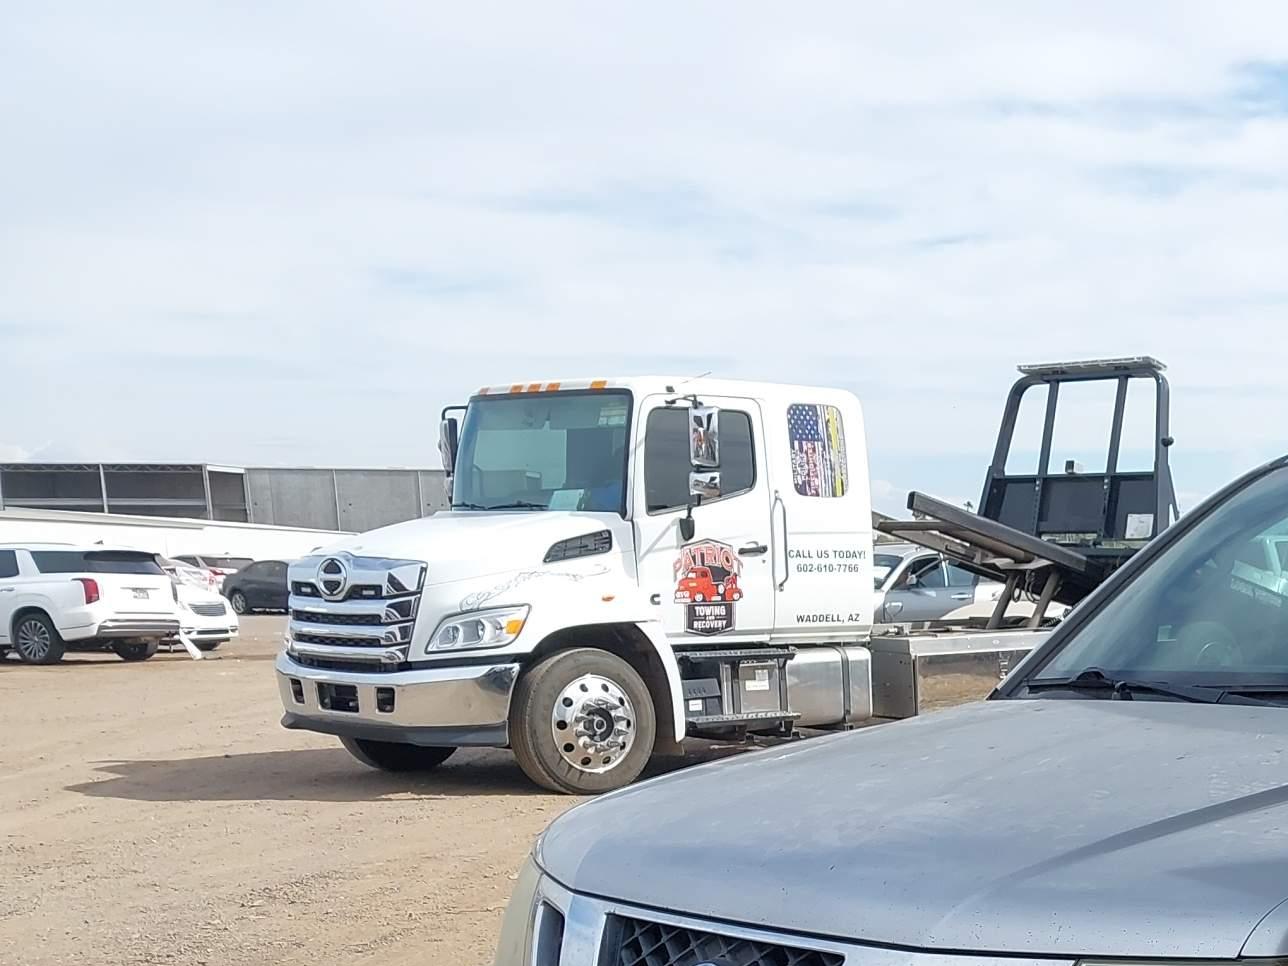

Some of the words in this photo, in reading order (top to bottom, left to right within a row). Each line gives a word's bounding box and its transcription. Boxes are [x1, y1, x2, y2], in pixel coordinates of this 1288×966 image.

[788, 549, 814, 559] CALL
[816, 549, 830, 559] US
[833, 550, 866, 560] TODAY!
[672, 543, 743, 581] PATRIOT
[796, 563, 859, 573] 602-610-7766
[694, 606, 726, 616] TOWING
[796, 613, 845, 624] WADDELL,
[847, 613, 861, 622] AZ
[694, 620, 727, 629] RECOVERY
